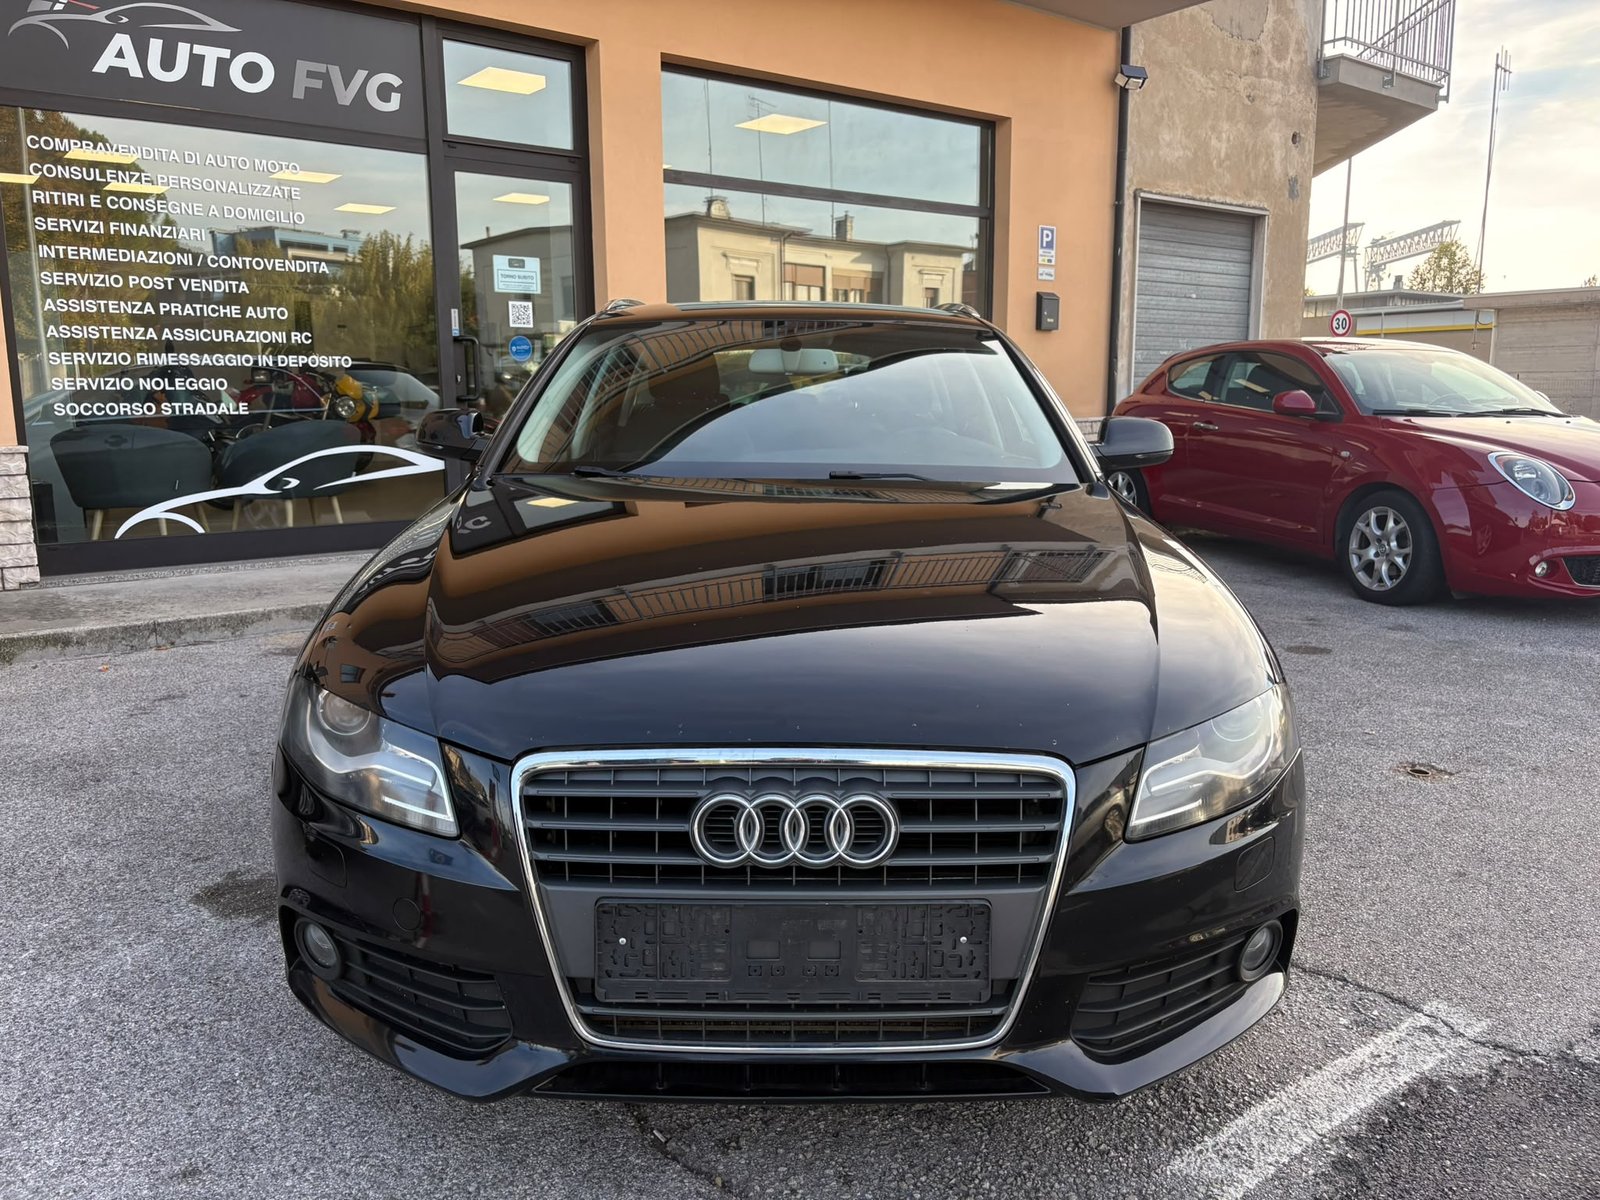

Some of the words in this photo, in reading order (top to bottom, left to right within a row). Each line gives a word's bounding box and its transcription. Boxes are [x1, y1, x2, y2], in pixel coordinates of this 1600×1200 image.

[92, 32, 275, 93] AUTO
[292, 59, 403, 112] FVG
[26, 135, 180, 163] COMPRAVENDITA
[185, 151, 201, 164] DI
[205, 153, 249, 170] AUTO
[254, 159, 300, 174] MOTO
[29, 163, 151, 186] CONSULENZE
[156, 175, 301, 200] PERSONALIZZATE
[32, 191, 84, 206] RITIRI
[90, 195, 100, 207] E
[106, 196, 202, 215] CONSEGNE
[207, 204, 219, 217] A
[223, 206, 305, 224] DOMICILIO
[34, 217, 104, 234] SERVIZI
[110, 222, 206, 241] FINANZIARI
[1043, 230, 1052, 247] P
[38, 244, 193, 265] INTERMEDIAZIONI
[197, 255, 204, 266] /
[207, 255, 329, 274] CONTOVENDITA
[40, 272, 123, 288] SERVIZIO
[129, 276, 174, 290] POST
[179, 279, 249, 294] VENDITA
[44, 298, 155, 315] ASSISTENZA
[159, 302, 241, 318] PRATICHE
[245, 306, 288, 320] AUTO
[46, 325, 157, 341] ASSISTENZA
[162, 328, 287, 344] ASSICURAZIONI
[291, 331, 312, 344] RC
[1334, 317, 1347, 330] 30
[48, 352, 131, 366] SERVIZIO
[136, 353, 253, 367] RIMESSAGGIO
[258, 355, 273, 367] IN
[277, 355, 352, 368] DEPOSITO
[51, 378, 133, 391] SERVIZIO
[139, 377, 227, 391] NOLEGGIO
[53, 402, 156, 416] SOCCORSO
[161, 402, 249, 415] STRADALE
